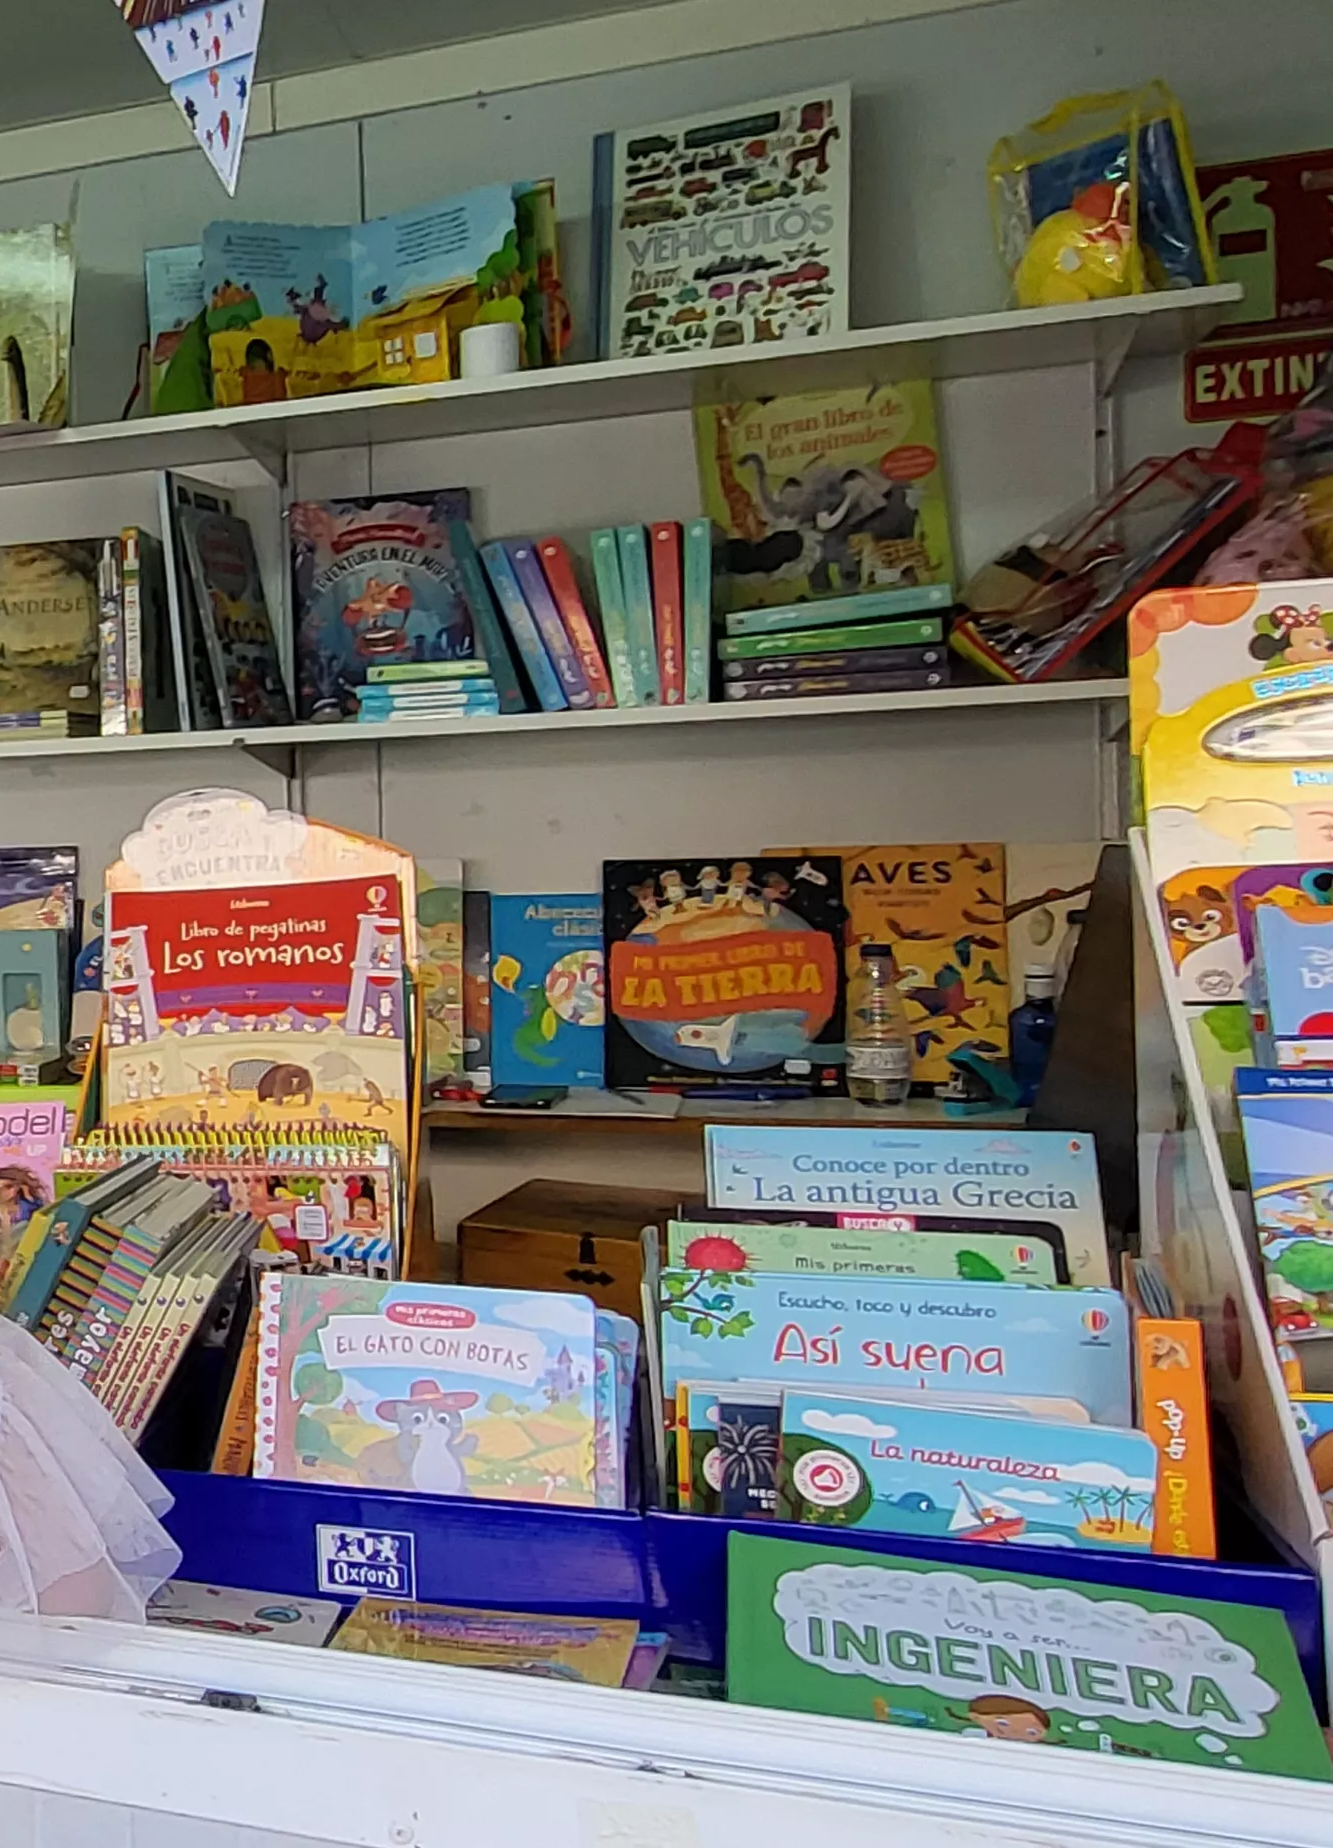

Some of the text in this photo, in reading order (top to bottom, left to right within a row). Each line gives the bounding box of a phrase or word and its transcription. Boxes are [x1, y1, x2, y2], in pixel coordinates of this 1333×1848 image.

[1195, 352, 1329, 404] EXTIN
[745, 399, 903, 442] El gran libro de
[767, 426, 894, 460] los animales
[850, 861, 952, 885] AVES
[181, 918, 326, 941] Libro de pegatinas
[164, 941, 344, 974] Los romanos
[658, 952, 722, 970] PRIMER
[727, 944, 777, 963] LIBRO
[784, 942, 805, 957] DE
[621, 964, 822, 1007] LA TIERRA
[792, 1154, 1030, 1181] Conoce por dentro
[753, 1176, 1078, 1211] La antigua Grecia
[795, 1256, 916, 1277] Mis primeras
[778, 1291, 997, 1319] Escucho, toco y descubro
[337, 1335, 528, 1371] EL GATO CON BOTAS
[773, 1322, 1005, 1376] Así suena
[871, 1438, 1062, 1483] La naturaleza
[333, 1560, 400, 1590] Oxford
[943, 1617, 995, 1639] Voy
[1004, 1629, 1018, 1641] a
[807, 1616, 1245, 1725] INGENIERA
